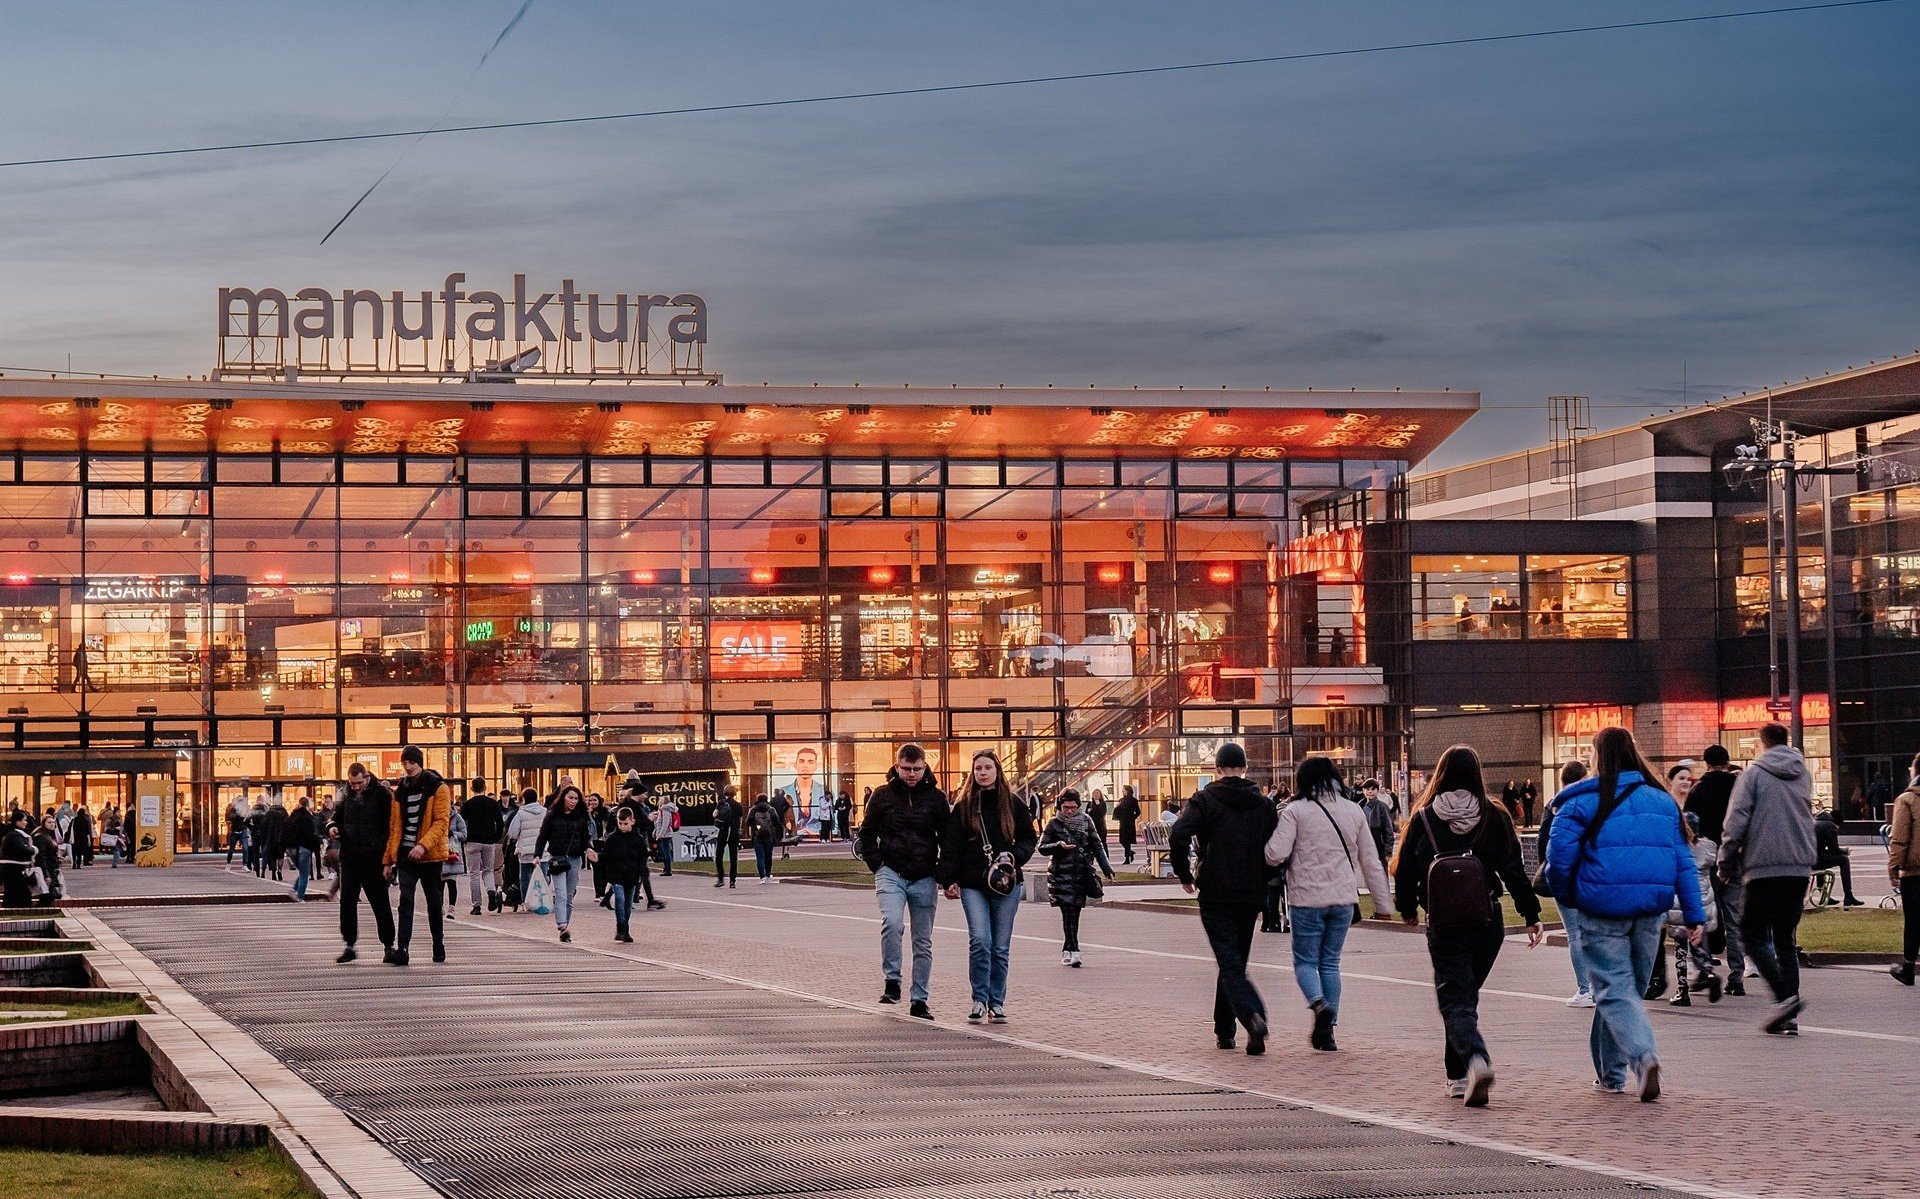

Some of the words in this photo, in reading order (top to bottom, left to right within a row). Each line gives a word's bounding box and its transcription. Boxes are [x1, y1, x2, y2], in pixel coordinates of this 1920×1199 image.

[218, 272, 708, 344] manufaktura
[3, 632, 42, 641] SYMBIOSIS
[721, 636, 787, 657] SALE
[1170, 766, 1203, 774] KNTOR
[654, 780, 716, 795] GRZANIEC
[648, 792, 720, 807] GICYJSKI
